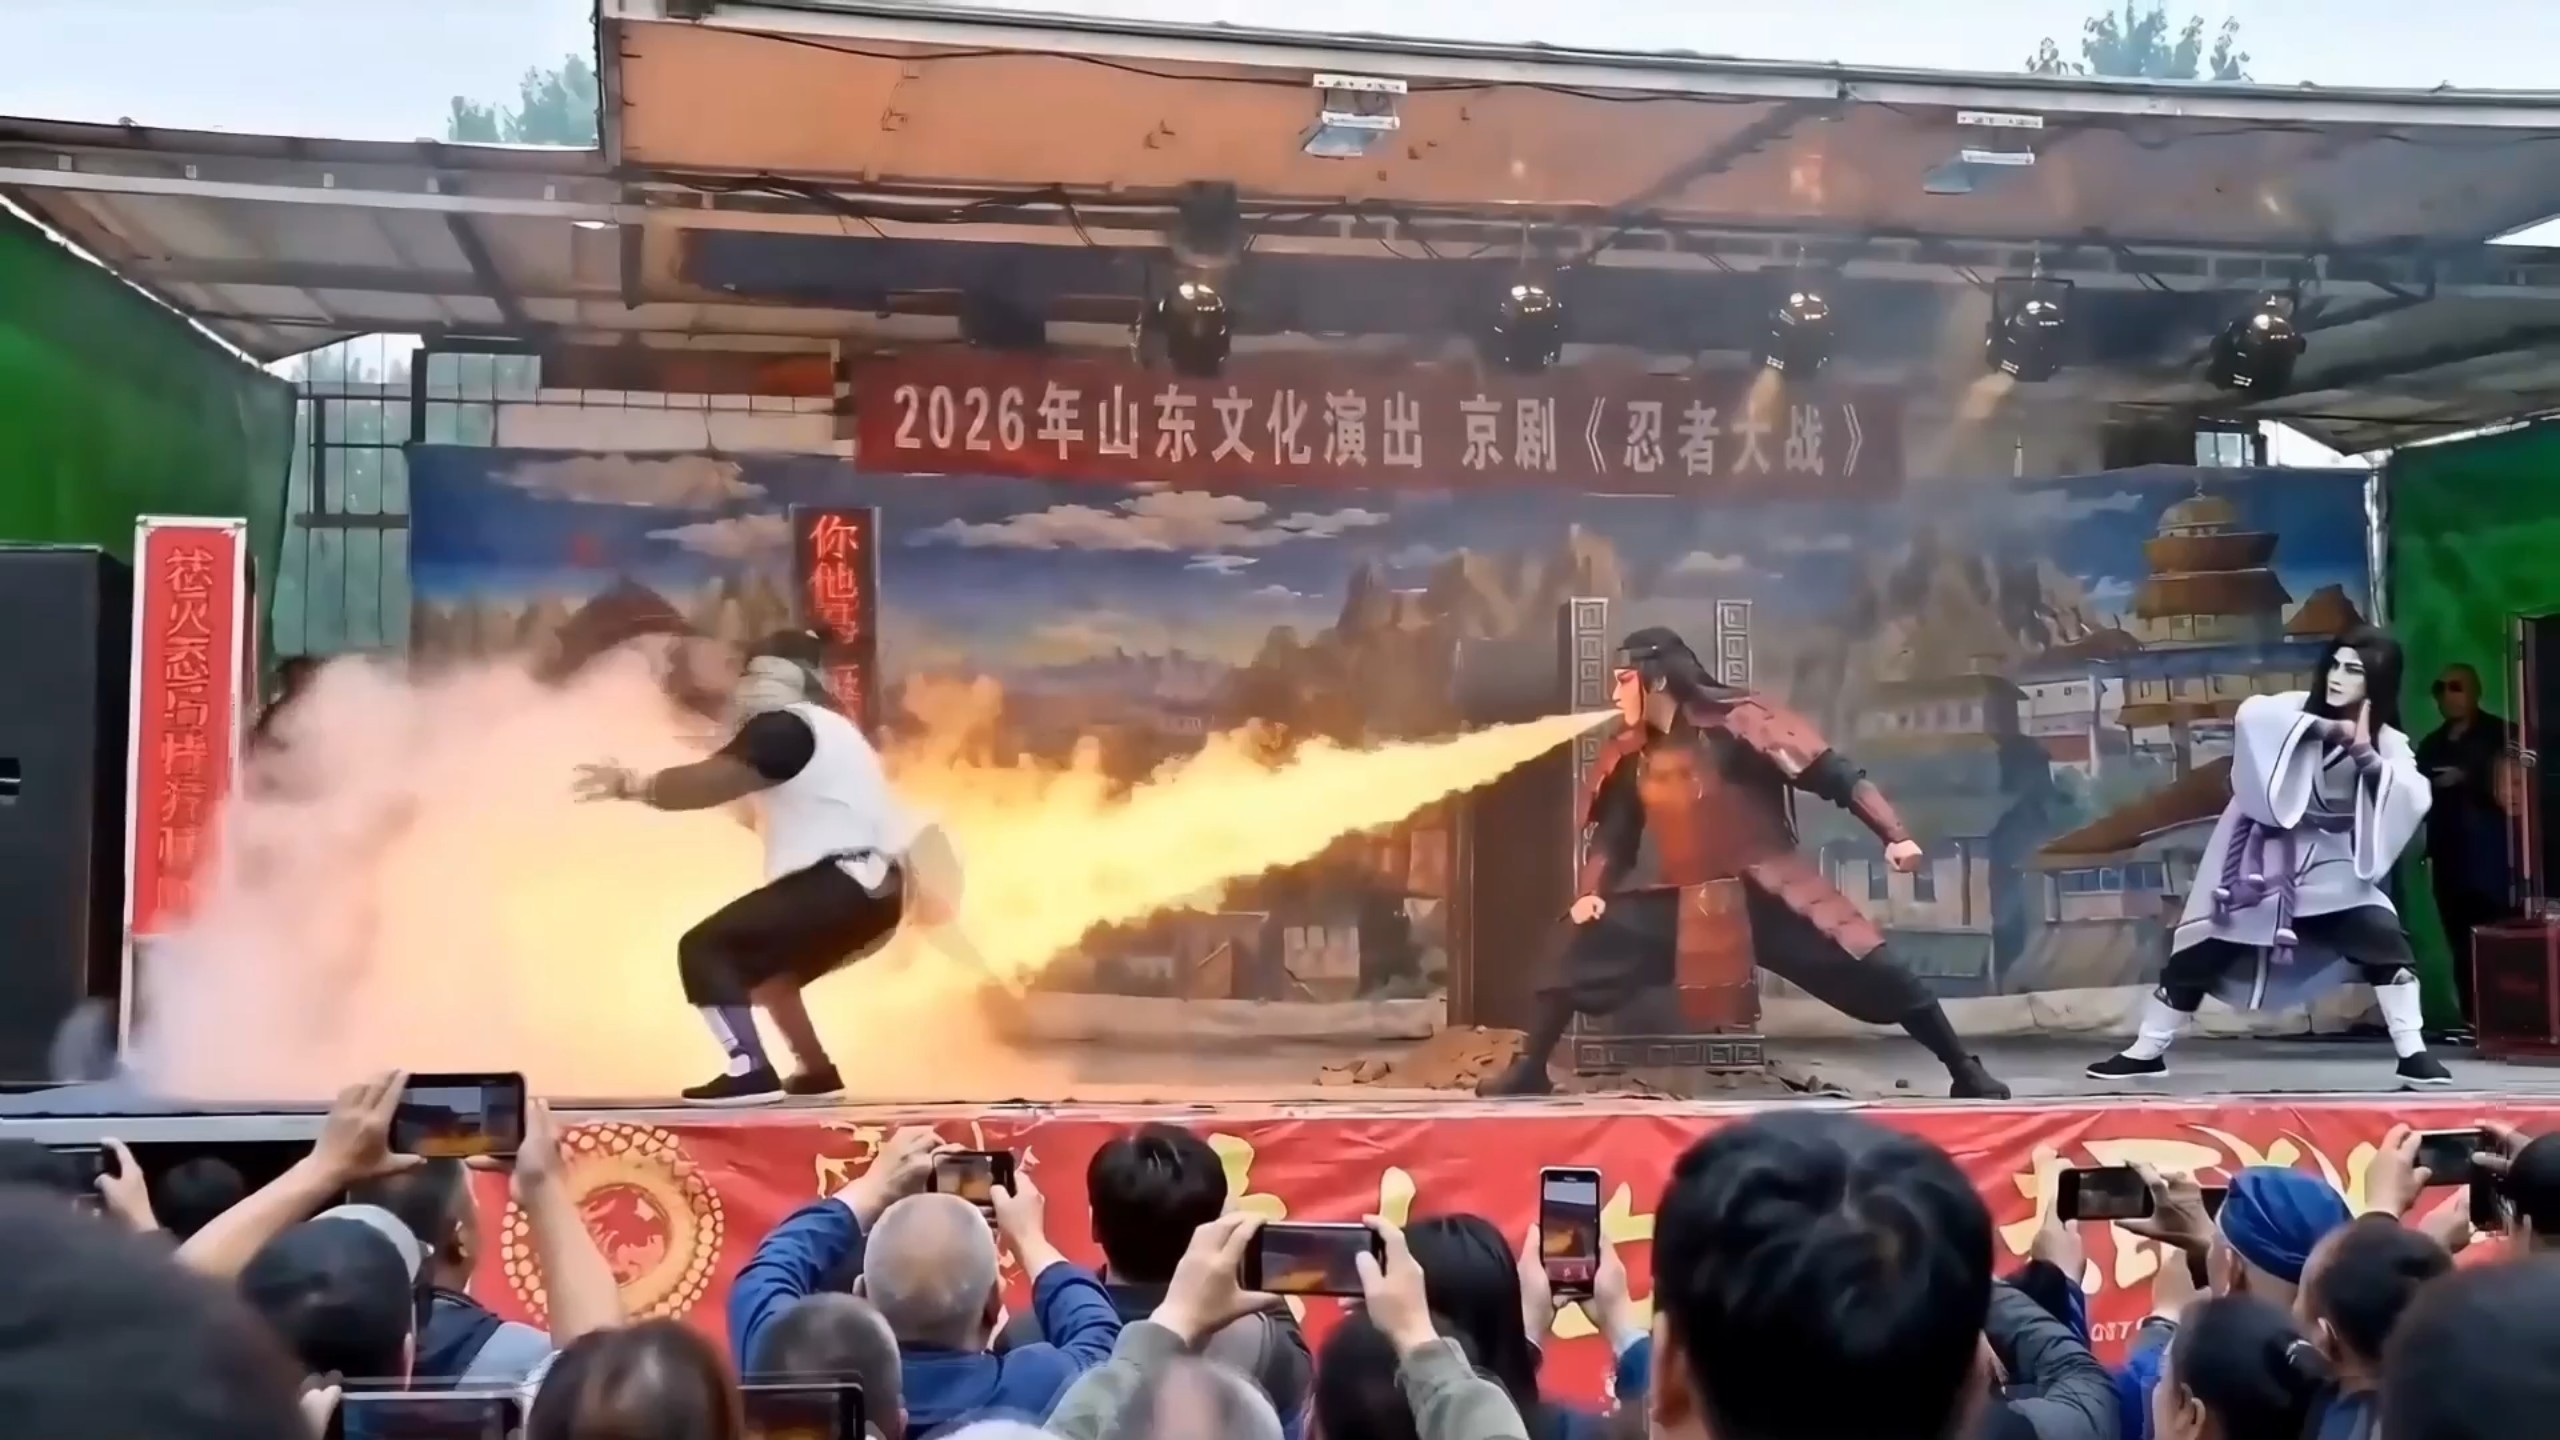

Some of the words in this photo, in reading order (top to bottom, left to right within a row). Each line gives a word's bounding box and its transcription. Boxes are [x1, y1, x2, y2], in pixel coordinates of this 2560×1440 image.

[893, 380, 1423, 469] 2026年山东文化演出
[1459, 394, 1863, 478] 京剧《忍者大战》
